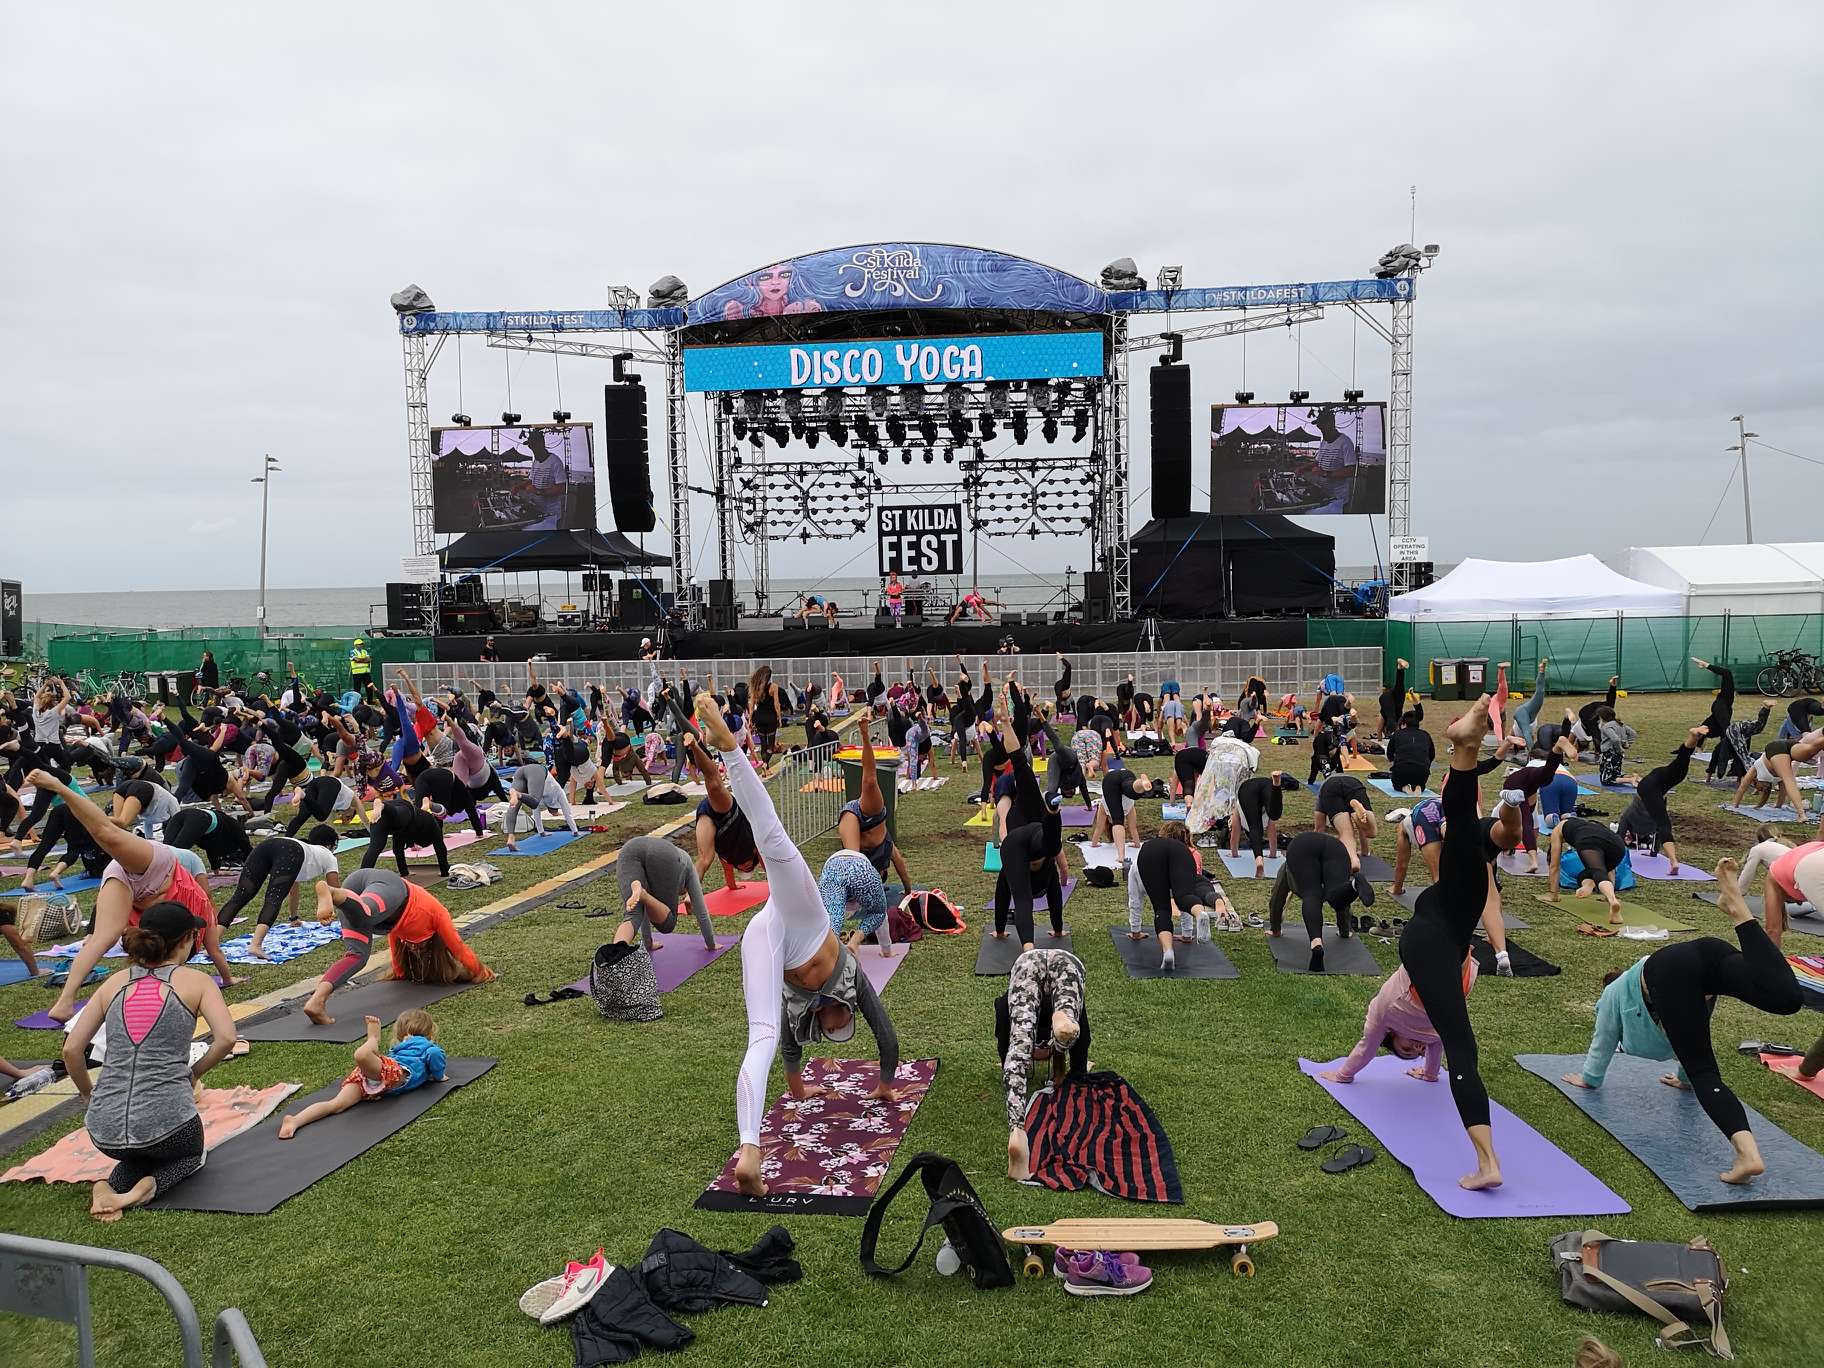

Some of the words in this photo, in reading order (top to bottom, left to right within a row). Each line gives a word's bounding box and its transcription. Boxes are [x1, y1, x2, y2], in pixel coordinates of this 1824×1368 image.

[884, 249, 921, 268] Kilda
[1215, 288, 1305, 301] #STKILDAFEST
[790, 348, 883, 386] DISCO
[895, 343, 983, 382] YOGA
[881, 510, 902, 531] ST
[906, 508, 957, 530] KILDA
[882, 534, 958, 572] FEST
